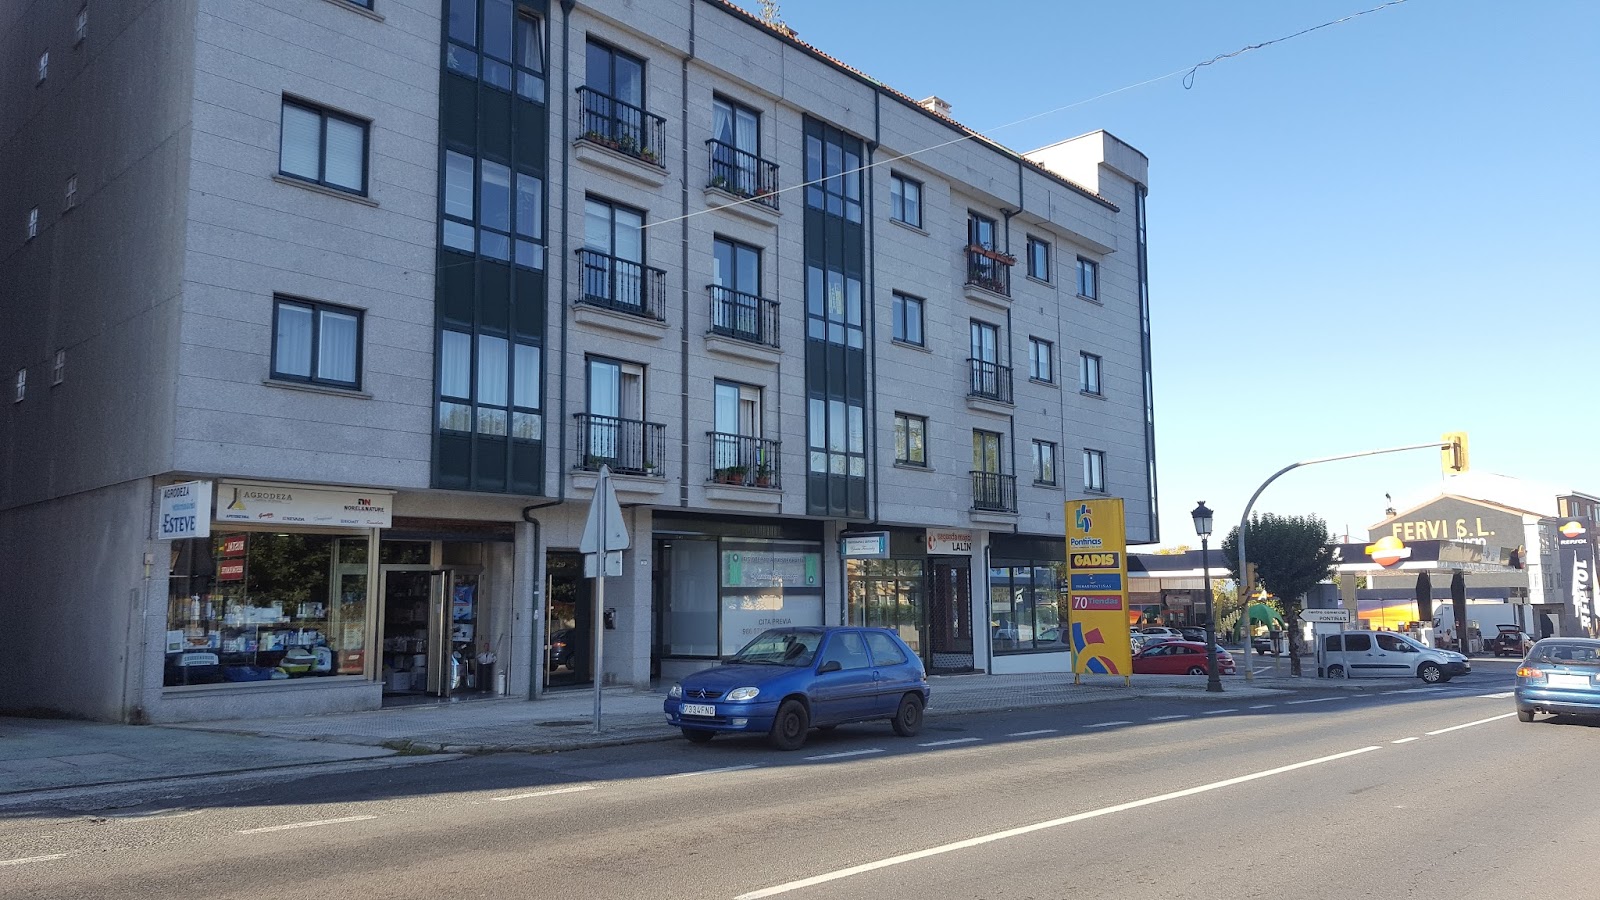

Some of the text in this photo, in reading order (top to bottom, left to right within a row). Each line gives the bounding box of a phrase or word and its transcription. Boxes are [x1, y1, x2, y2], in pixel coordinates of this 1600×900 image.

[164, 486, 189, 498] AGRODEZA
[243, 491, 293, 501] AGRODEZA
[1392, 517, 1495, 540] FERVI S. L.
[1074, 554, 1114, 566] GADIS
[1074, 597, 1088, 609] 70
[758, 618, 771, 626] CITA
